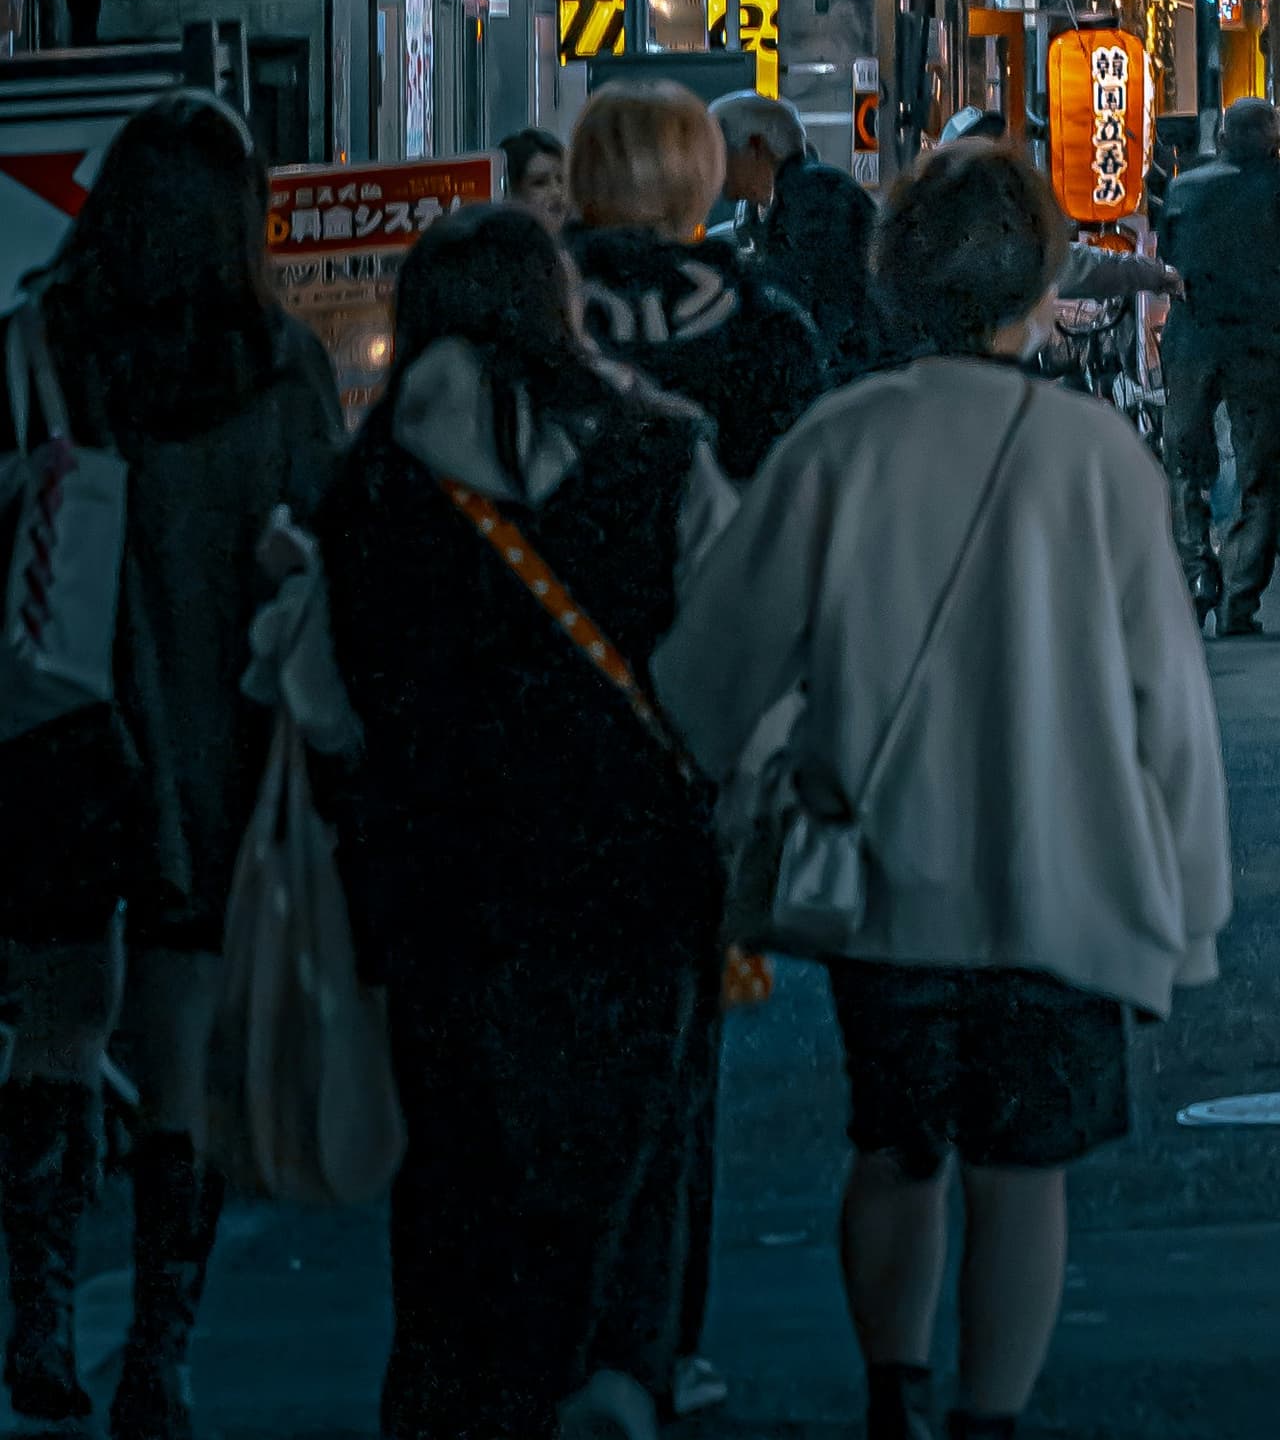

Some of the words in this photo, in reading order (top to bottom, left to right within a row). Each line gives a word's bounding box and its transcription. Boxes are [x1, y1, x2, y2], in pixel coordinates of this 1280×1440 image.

[1091, 47, 1130, 207] 韓国立呑み
